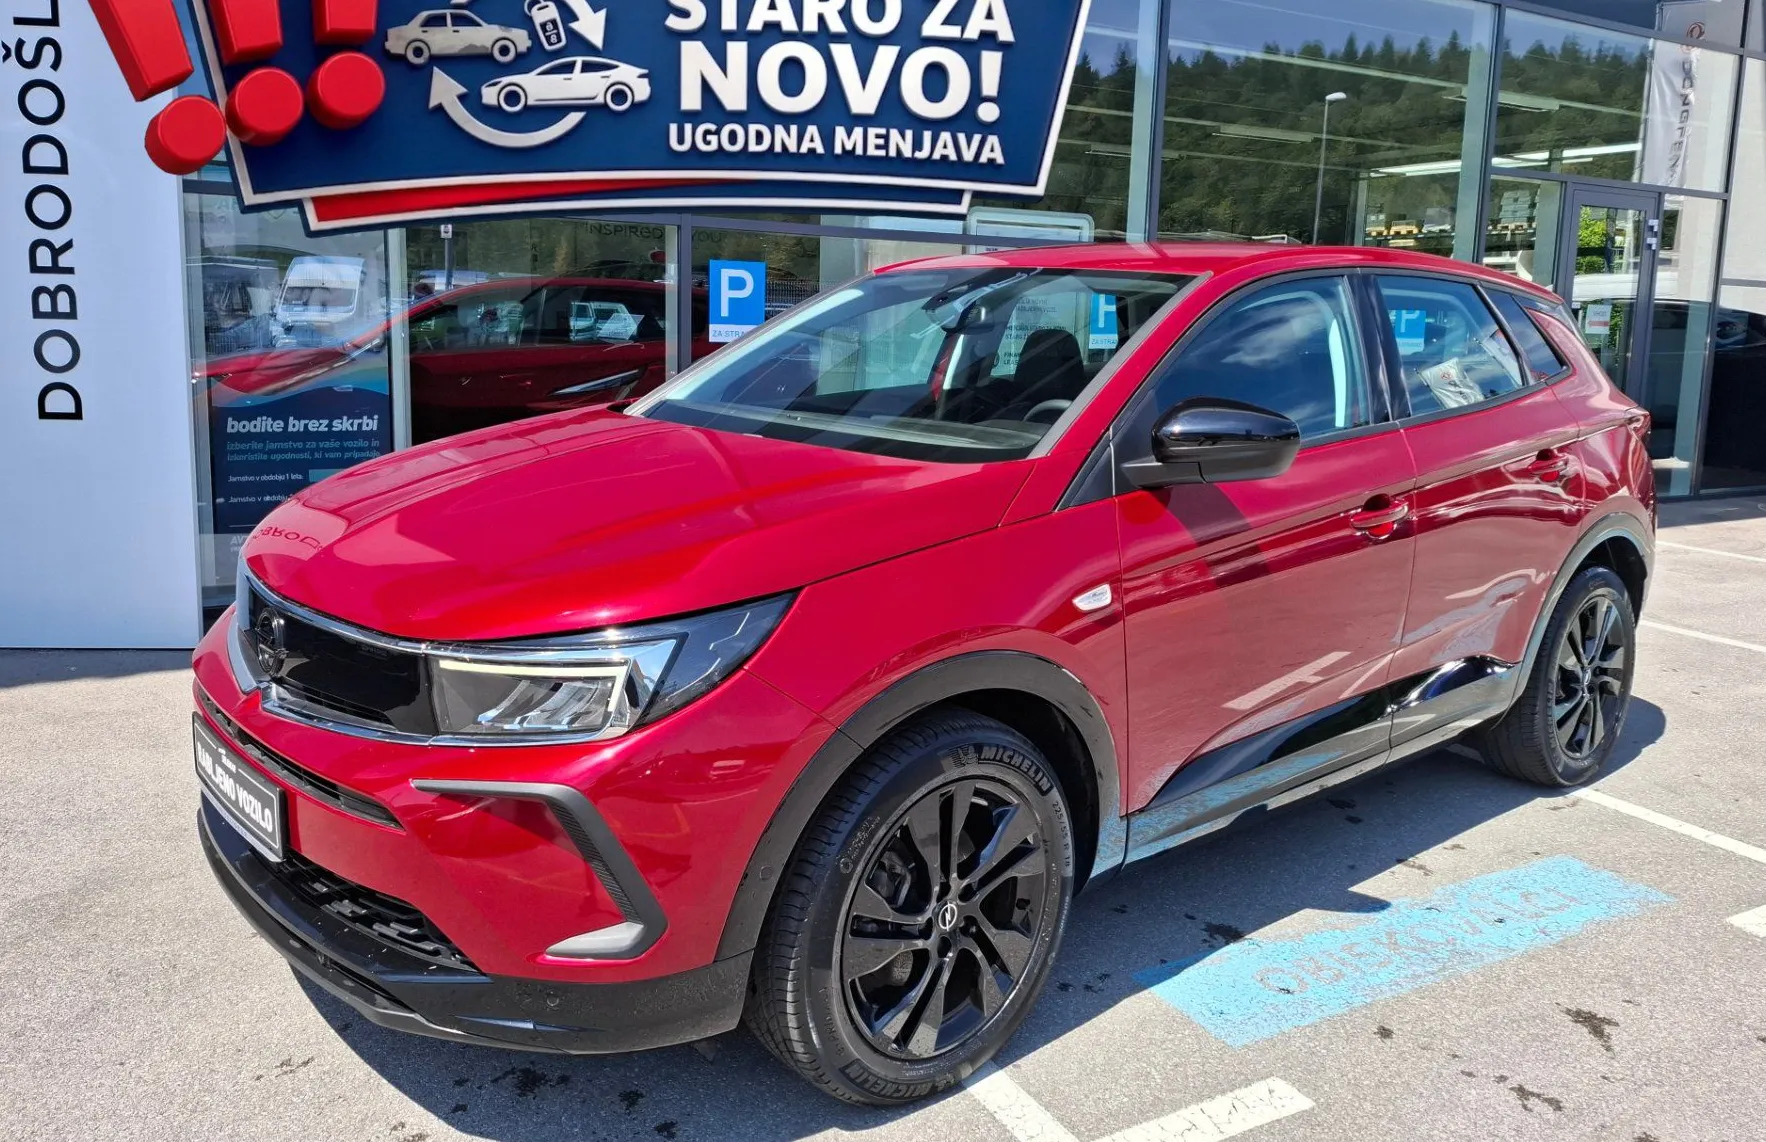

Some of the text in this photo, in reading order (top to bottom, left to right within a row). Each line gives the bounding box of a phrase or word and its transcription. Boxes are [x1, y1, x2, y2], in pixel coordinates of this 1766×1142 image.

[720, 268, 754, 317] P
[226, 414, 379, 433] bodite brez skrbi
[265, 440, 302, 451] jamstvo
[305, 441, 317, 449] za
[319, 438, 341, 449] vaše
[343, 439, 368, 448] vozilo
[371, 438, 380, 447] in
[227, 474, 255, 483] Jamstvo
[980, 746, 1052, 792] MICHELIN
